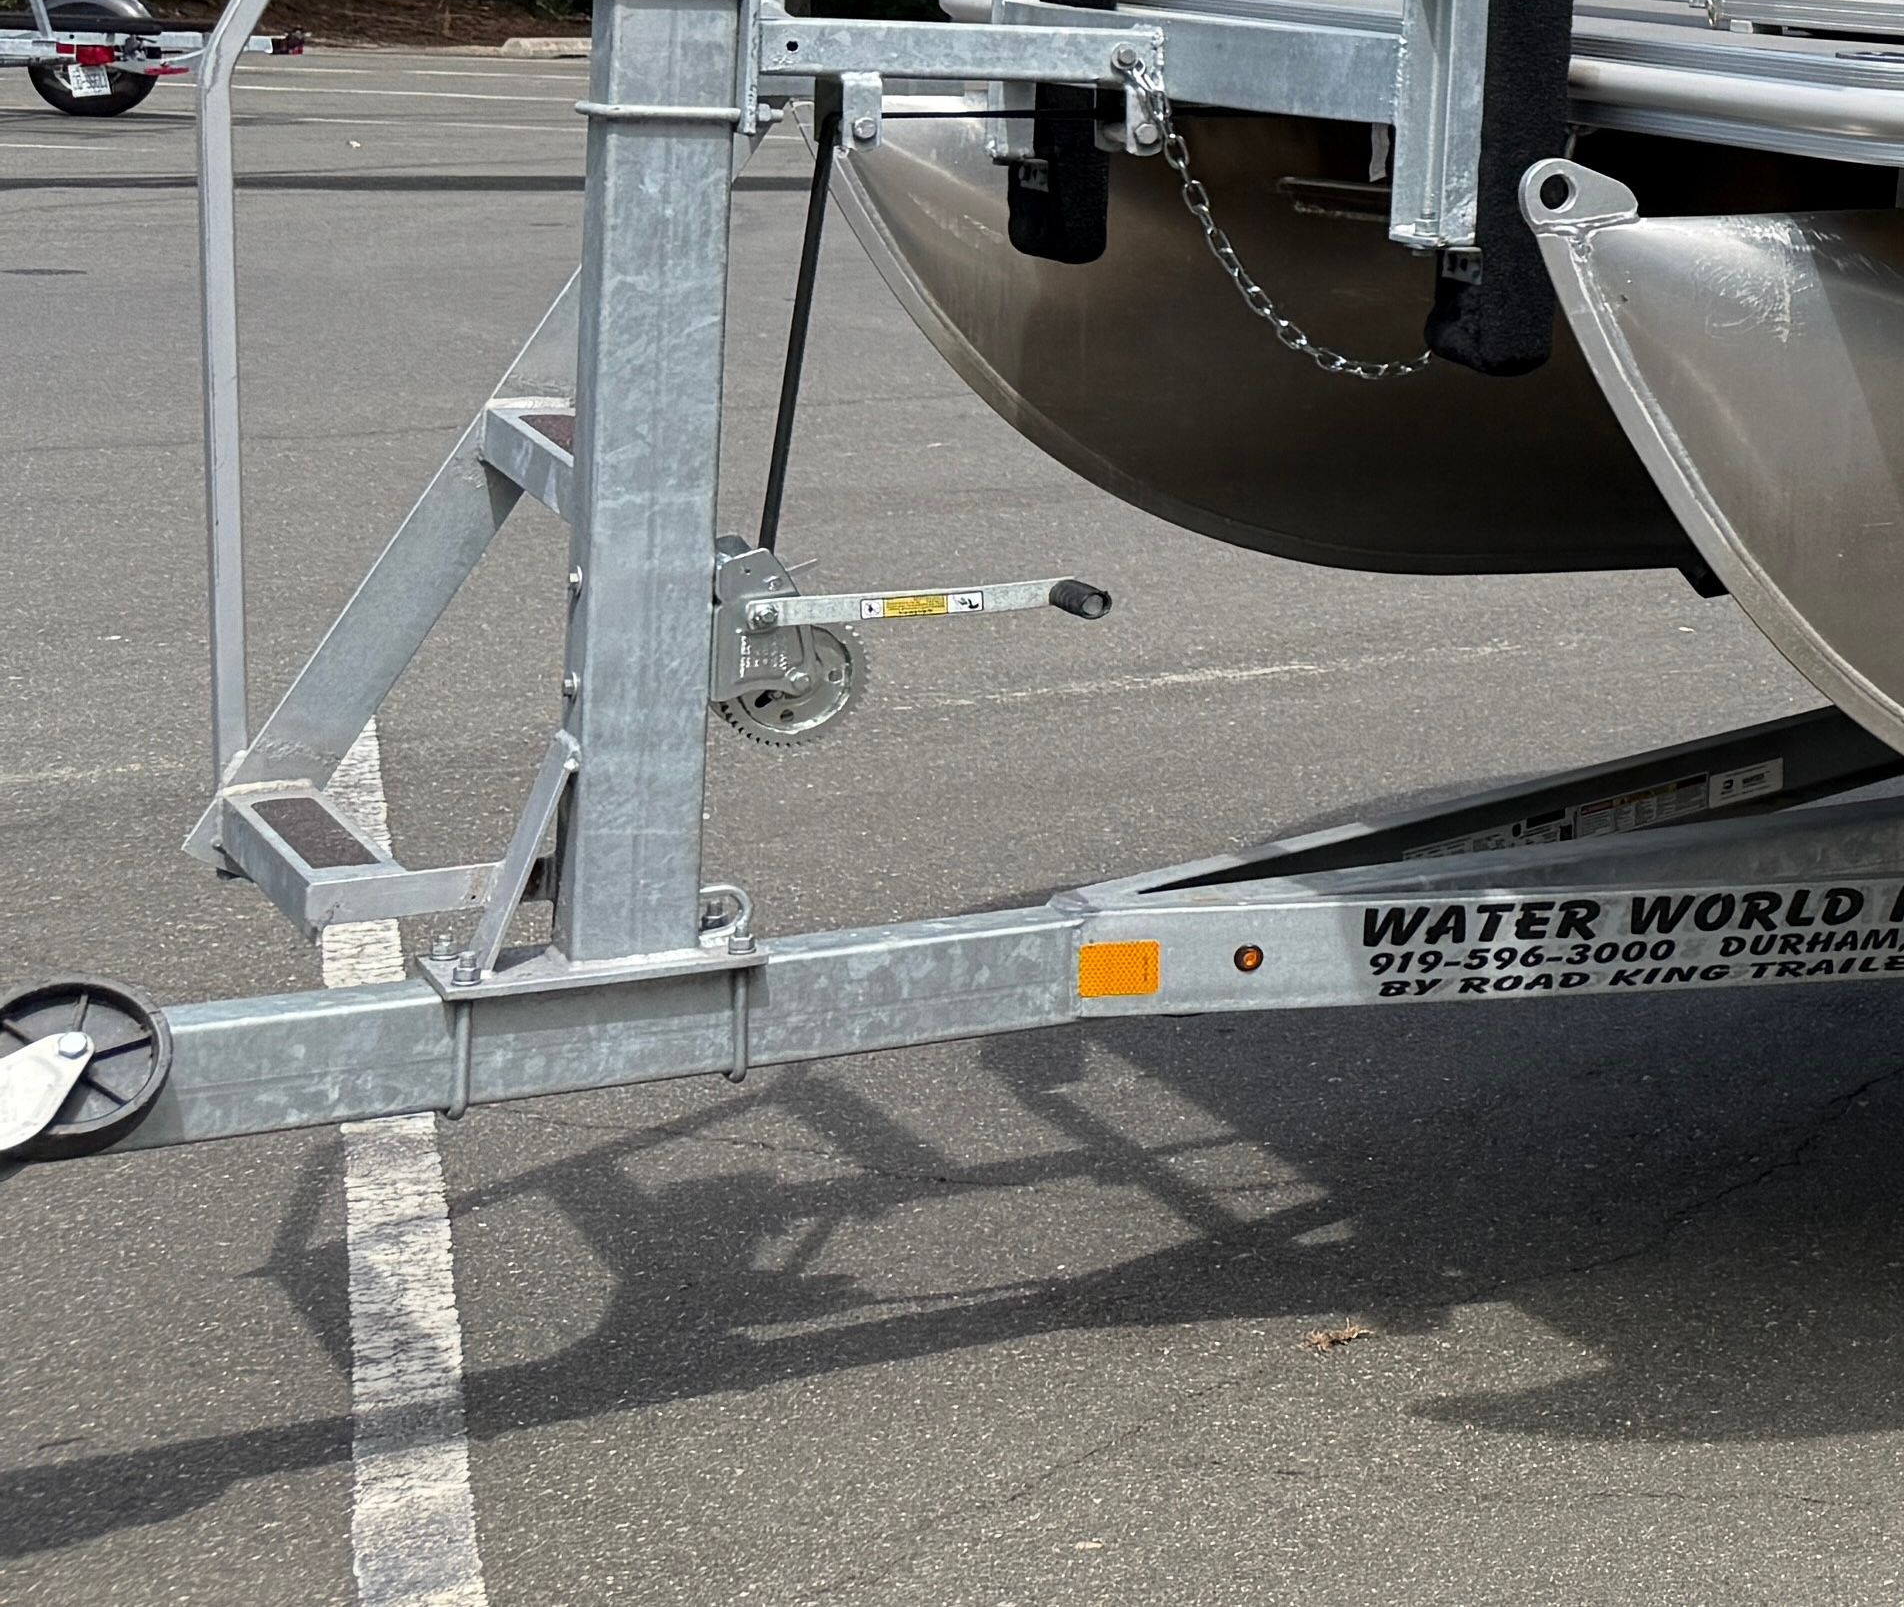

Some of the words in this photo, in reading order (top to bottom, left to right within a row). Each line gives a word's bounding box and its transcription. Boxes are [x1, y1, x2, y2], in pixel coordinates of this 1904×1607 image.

[1363, 899, 1601, 947] WATER
[1630, 887, 1865, 935] WORLD
[1369, 939, 1677, 976] 919-596-3000
[1378, 978, 1443, 997] BY
[1457, 972, 1591, 994] ROAD
[1608, 964, 1731, 987] KING
